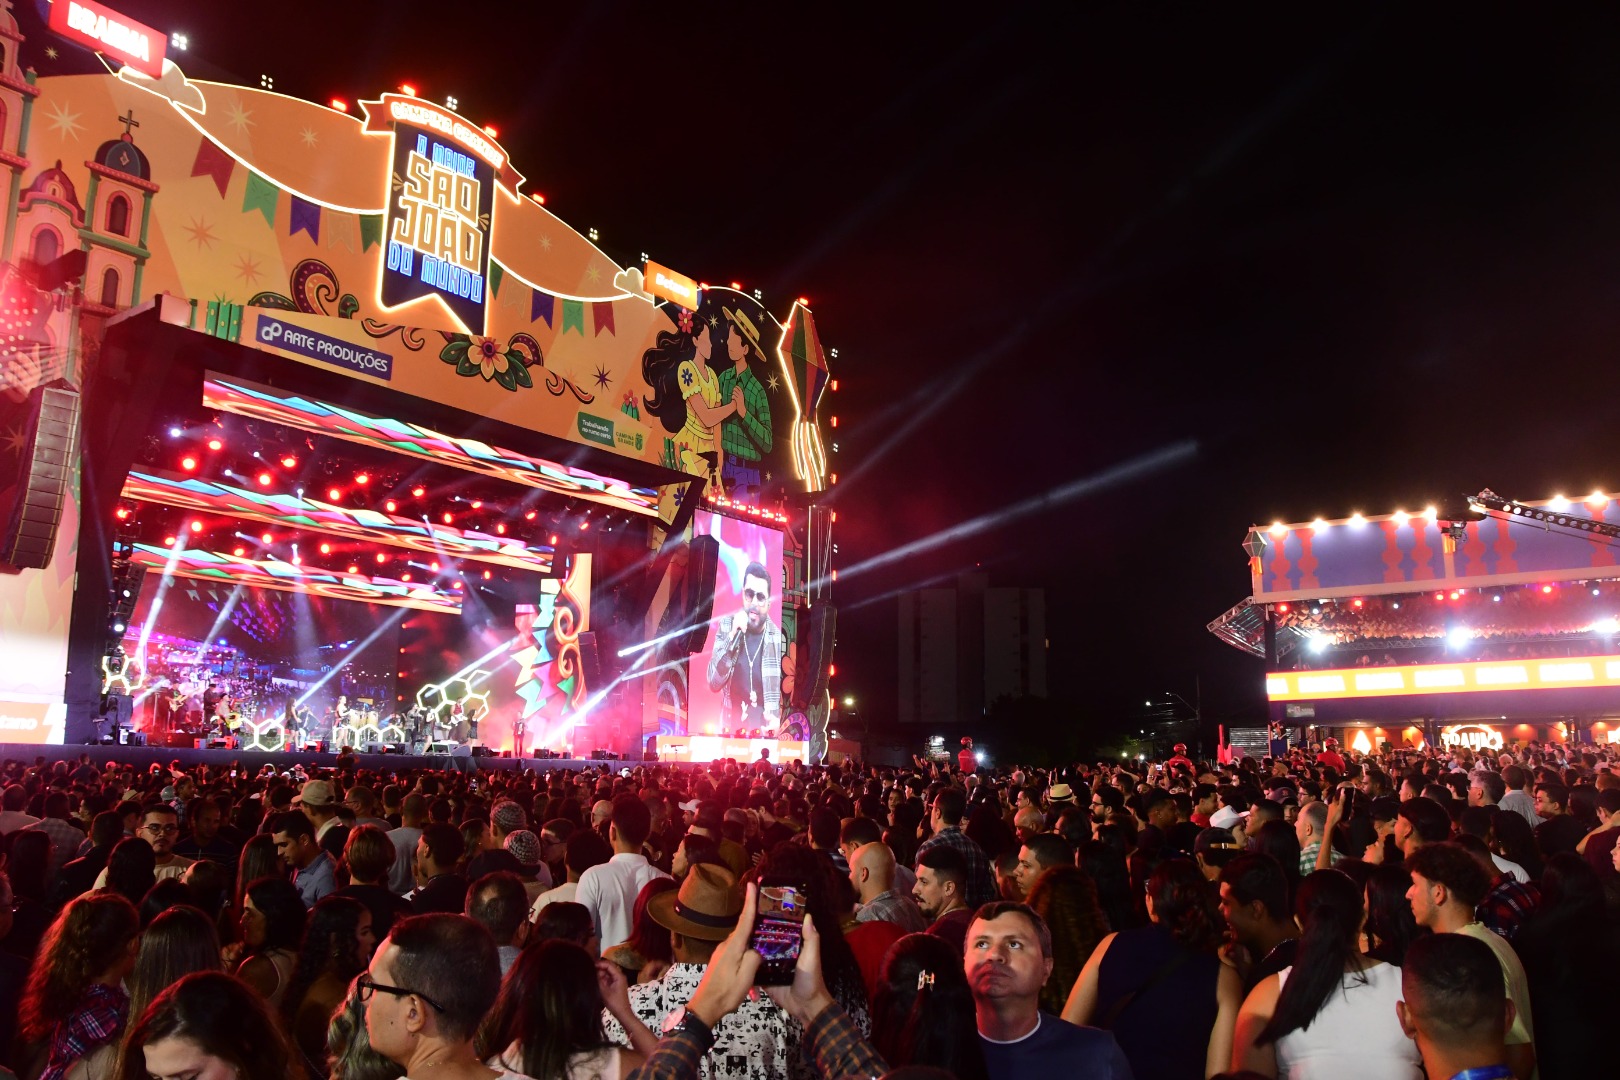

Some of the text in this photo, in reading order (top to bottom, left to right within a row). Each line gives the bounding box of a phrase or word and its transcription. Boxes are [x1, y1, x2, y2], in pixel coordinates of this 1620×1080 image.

[391, 101, 504, 169] CAMPINA GRANDE
[417, 134, 475, 179] O MAIOR
[387, 239, 483, 304] DO MUNDO
[283, 329, 314, 350] ARTE
[316, 340, 388, 373] PRODUÇÕES
